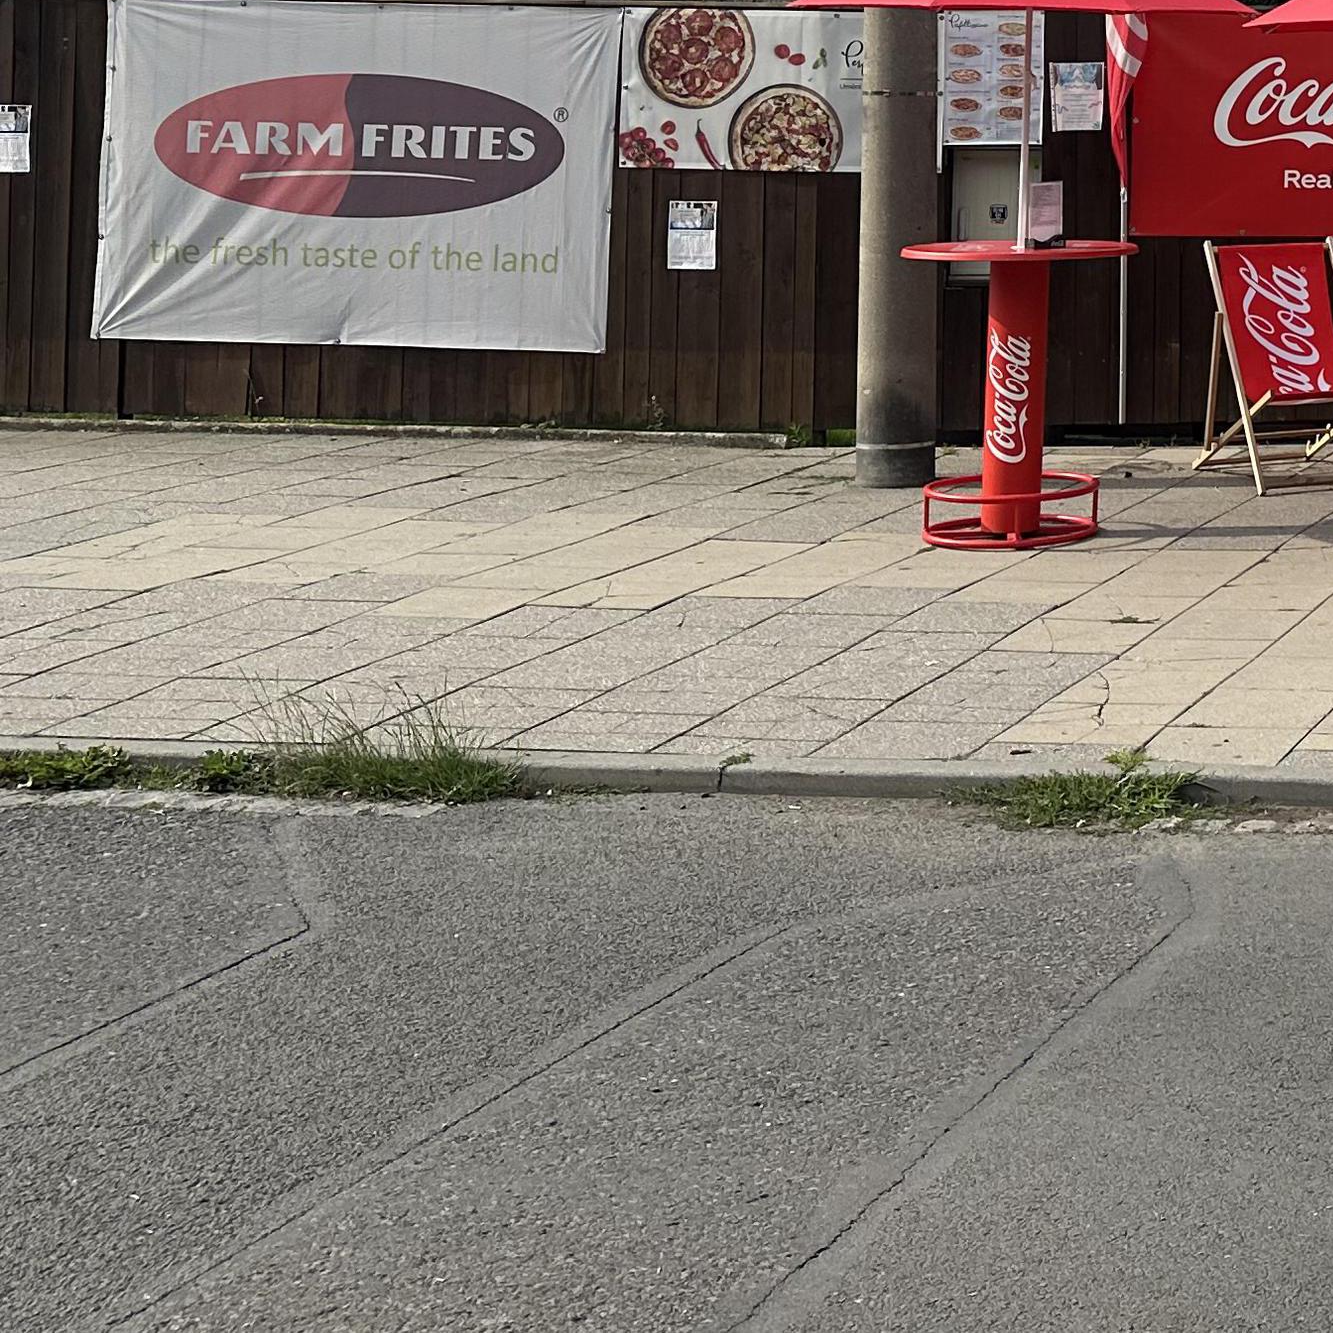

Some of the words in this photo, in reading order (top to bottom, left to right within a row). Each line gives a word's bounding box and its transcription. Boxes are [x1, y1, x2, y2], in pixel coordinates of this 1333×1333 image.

[185, 119, 345, 157] FARM
[361, 123, 537, 163] FRITES
[150, 235, 200, 265] the
[211, 237, 288, 267] fresh
[301, 242, 377, 270] taste
[388, 241, 422, 270] of
[431, 243, 482, 272] the
[492, 244, 560, 274] land
[985, 326, 1032, 464] Coca-Cola
